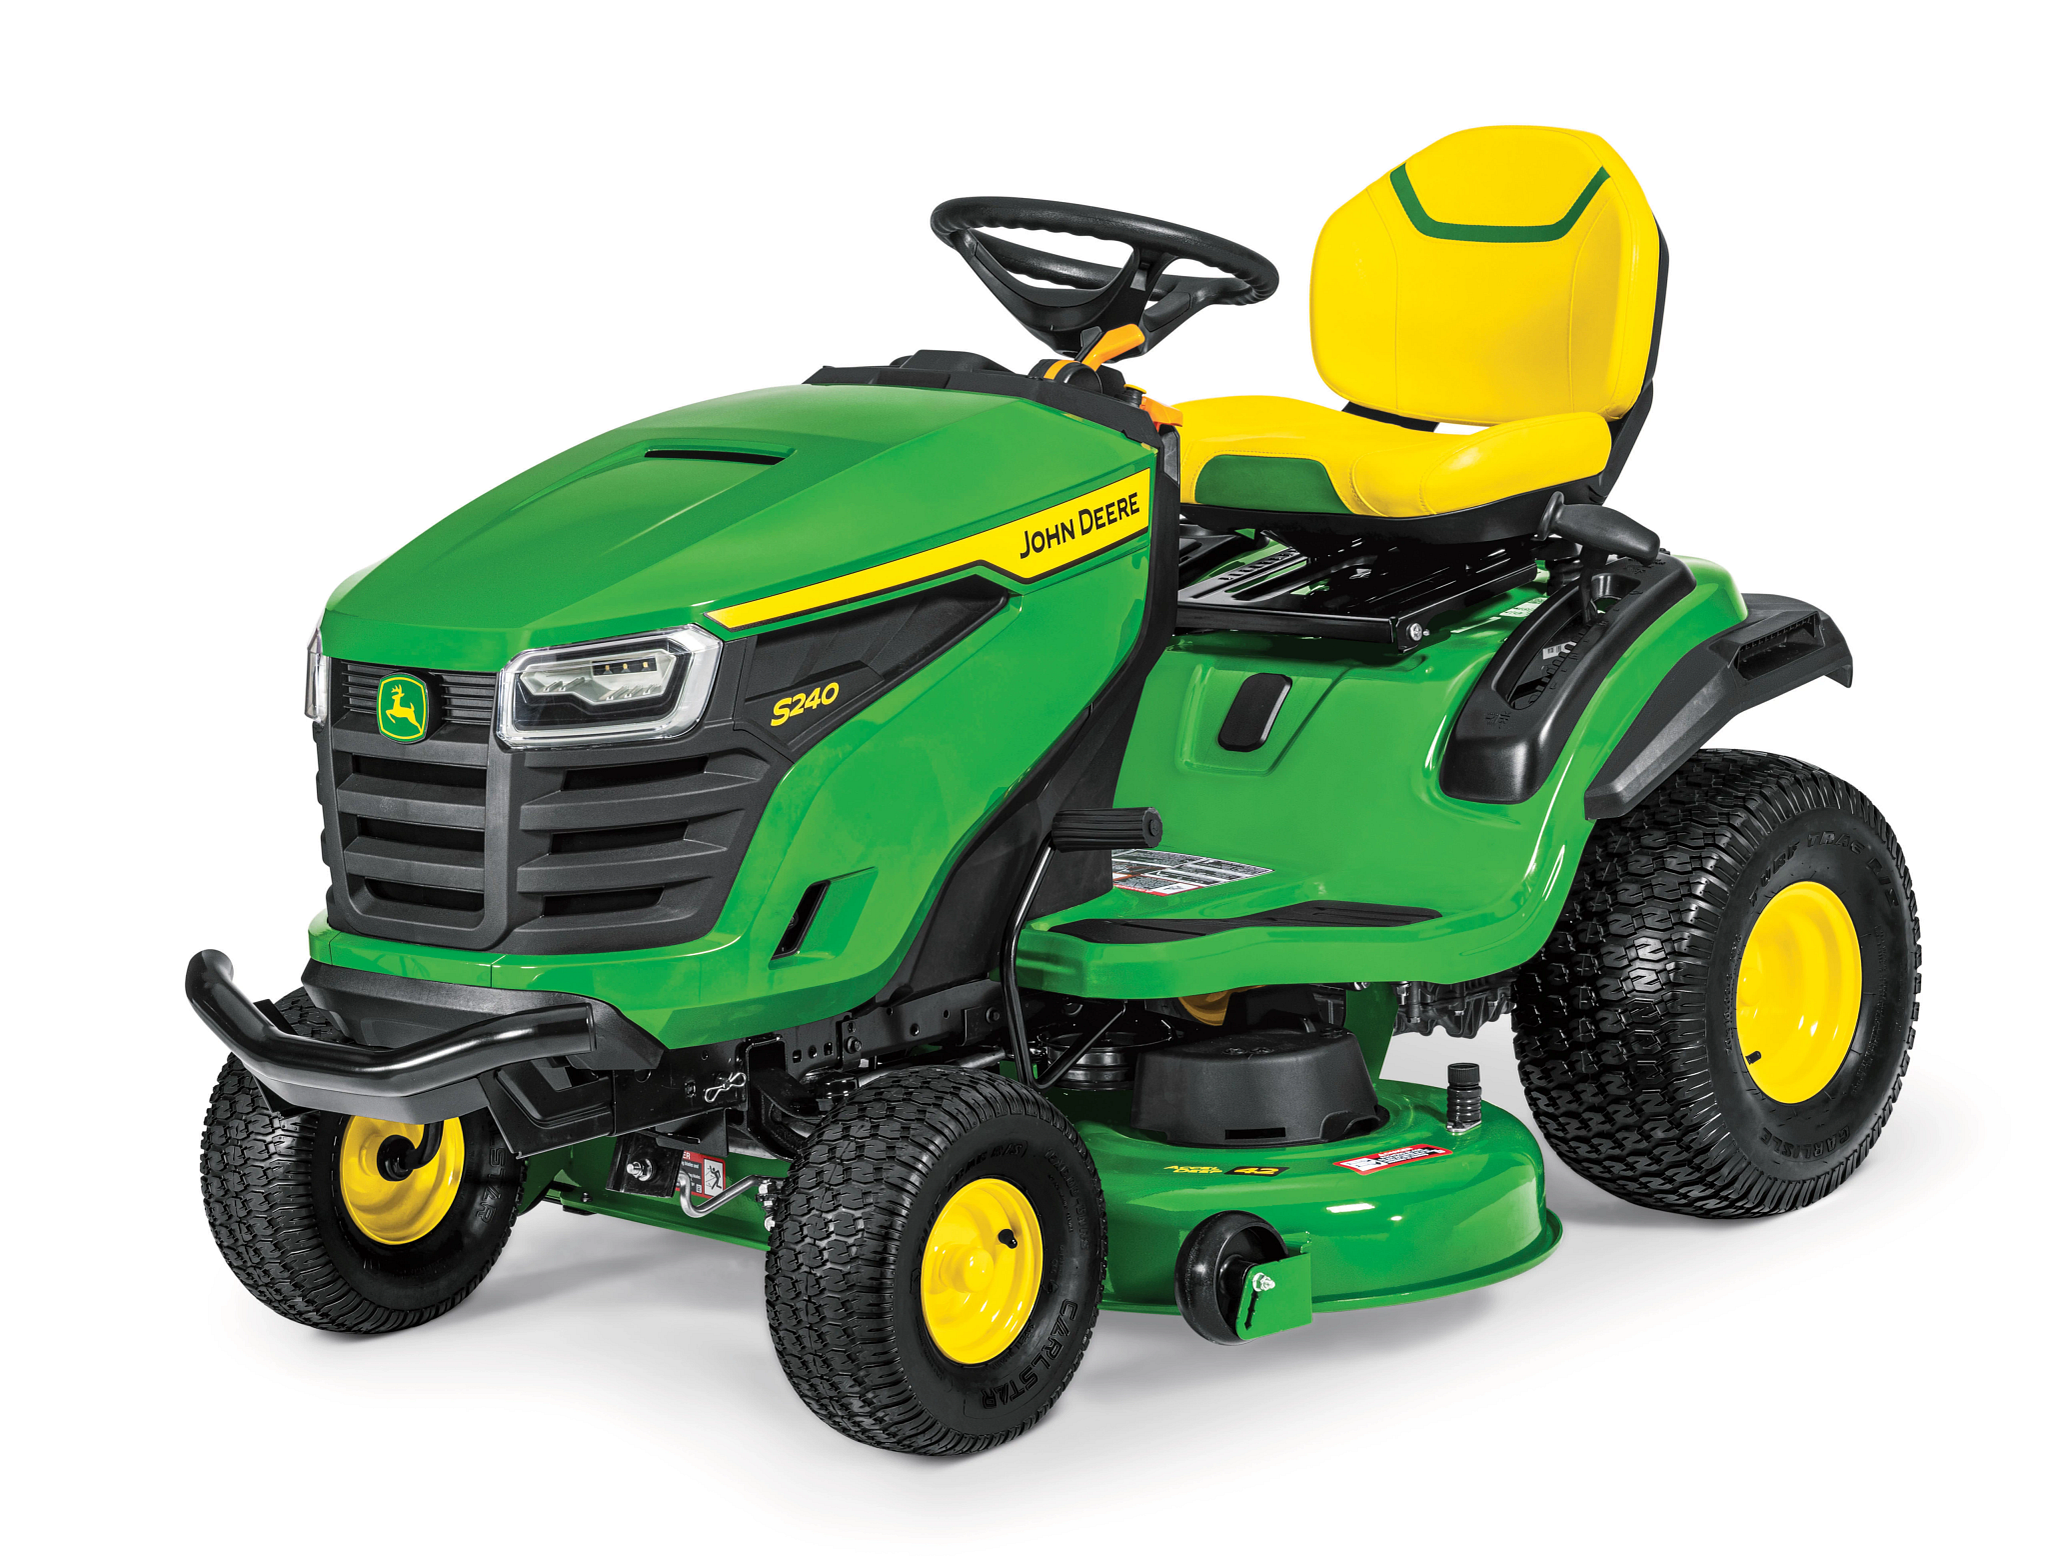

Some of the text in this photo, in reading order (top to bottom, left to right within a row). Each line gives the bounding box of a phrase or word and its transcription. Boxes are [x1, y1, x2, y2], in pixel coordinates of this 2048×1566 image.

[1020, 492, 1140, 559] JOHN DEERE
[770, 682, 839, 727] S240
[1759, 1126, 1850, 1158] CARLISLE
[1233, 1167, 1279, 1175] 42
[981, 1299, 1078, 1409] CARLSTAR
